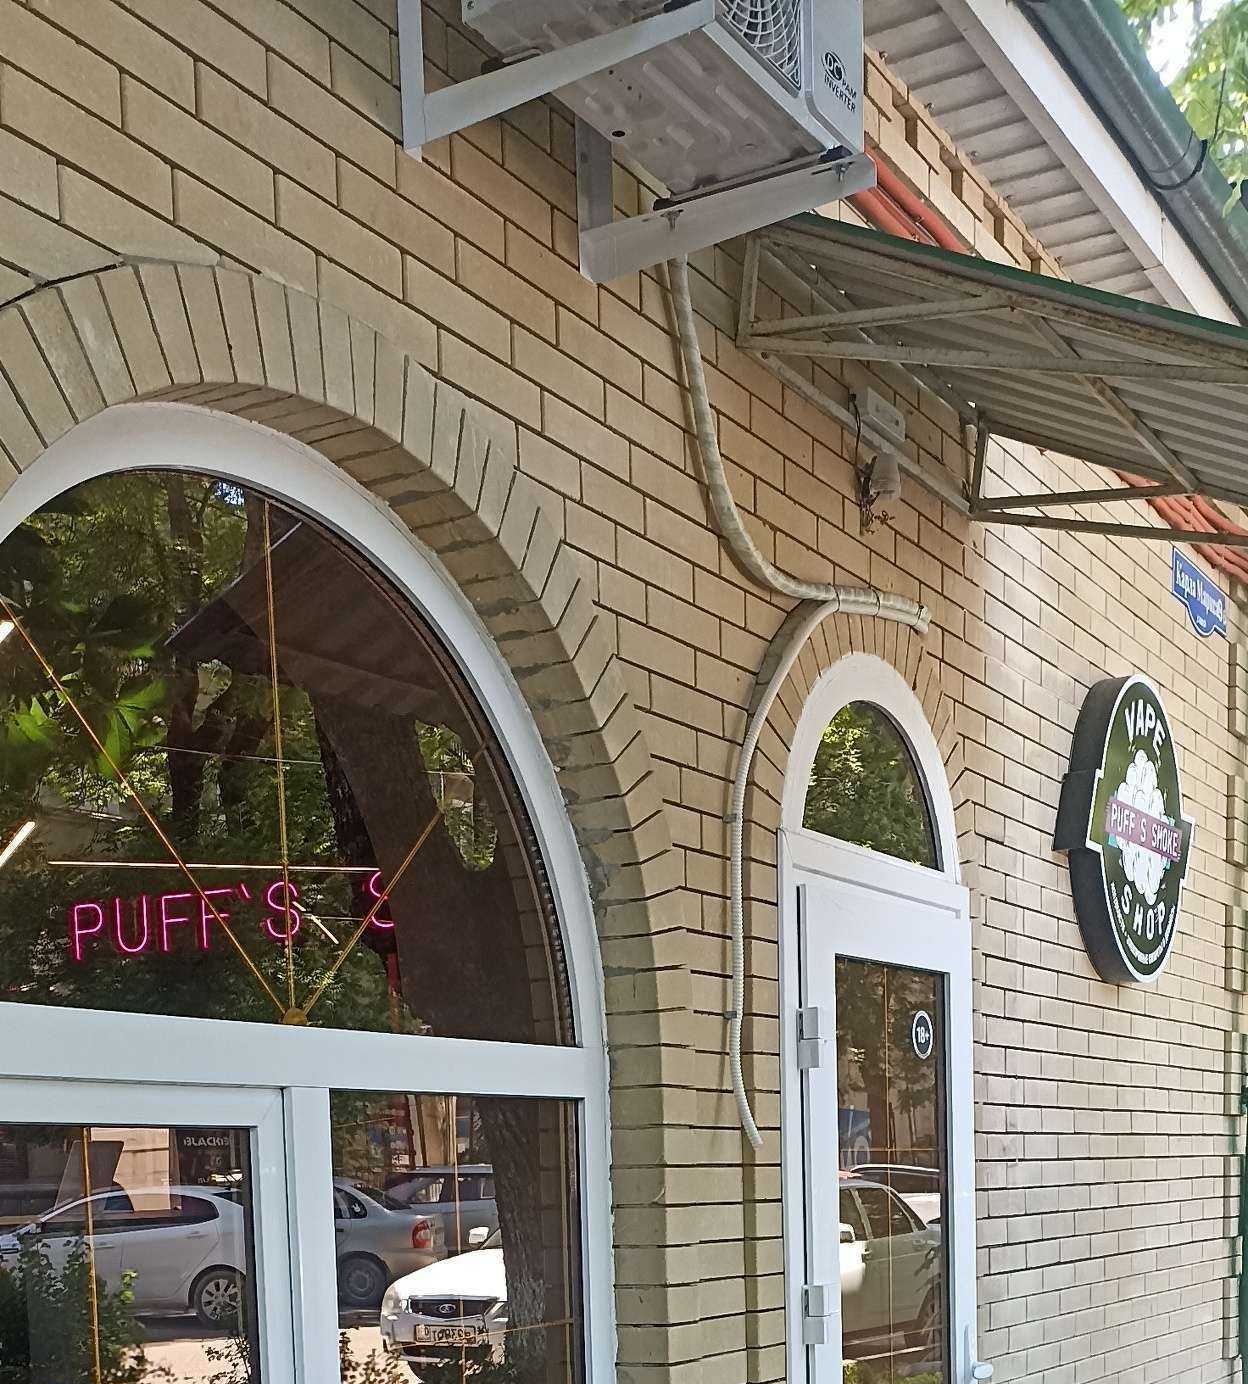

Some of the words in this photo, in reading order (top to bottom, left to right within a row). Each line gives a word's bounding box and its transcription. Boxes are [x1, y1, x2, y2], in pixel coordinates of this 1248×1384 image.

[824, 52, 843, 81] DC
[824, 73, 857, 112] INVERTER
[1176, 561, 1197, 598] Карла
[1125, 699, 1166, 756] VAPE
[1121, 884, 1166, 940] SHOP
[916, 1026, 930, 1044] 18+
